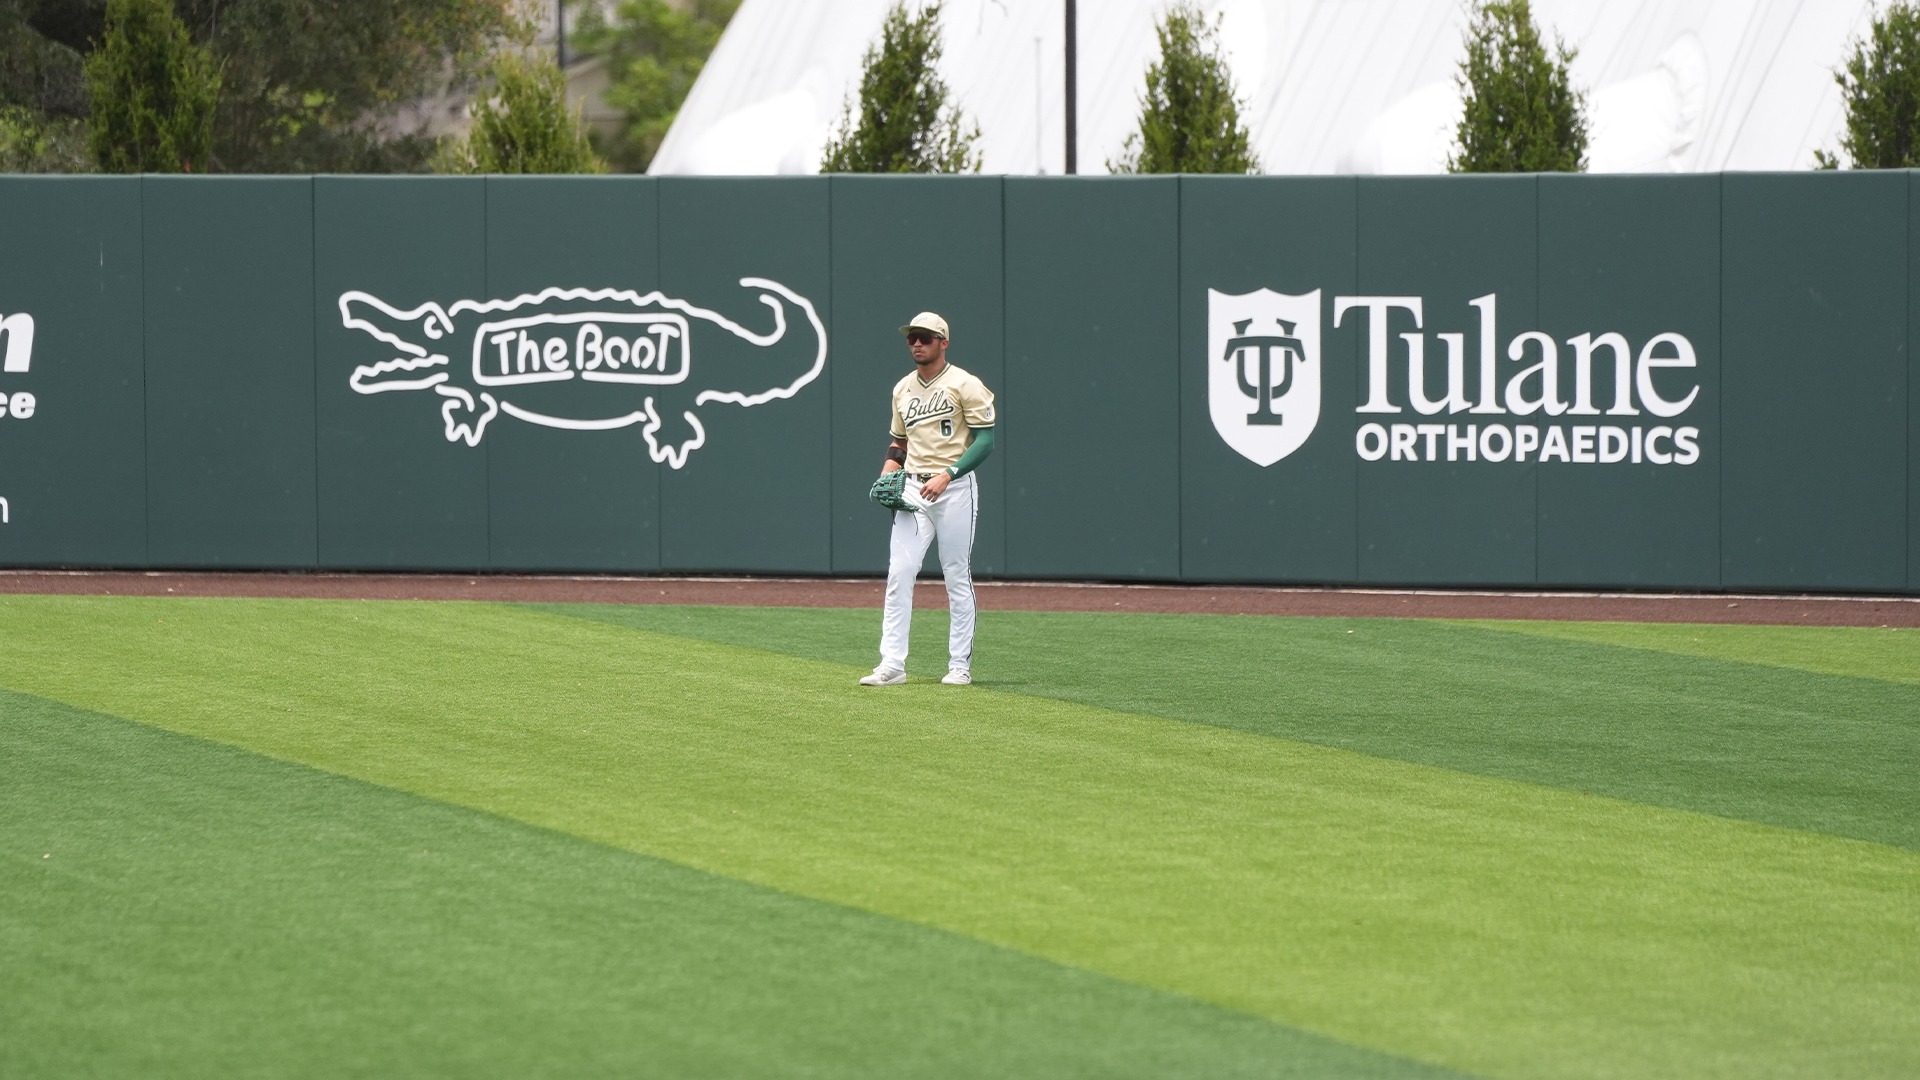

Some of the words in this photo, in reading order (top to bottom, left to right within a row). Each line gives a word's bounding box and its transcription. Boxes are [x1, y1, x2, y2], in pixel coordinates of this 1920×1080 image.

[490, 329, 569, 373] The
[1333, 293, 1700, 417] Tulane
[903, 390, 949, 421] Bulls
[941, 418, 952, 437] 6
[1356, 423, 1700, 465] ORTHOPAEDICS
